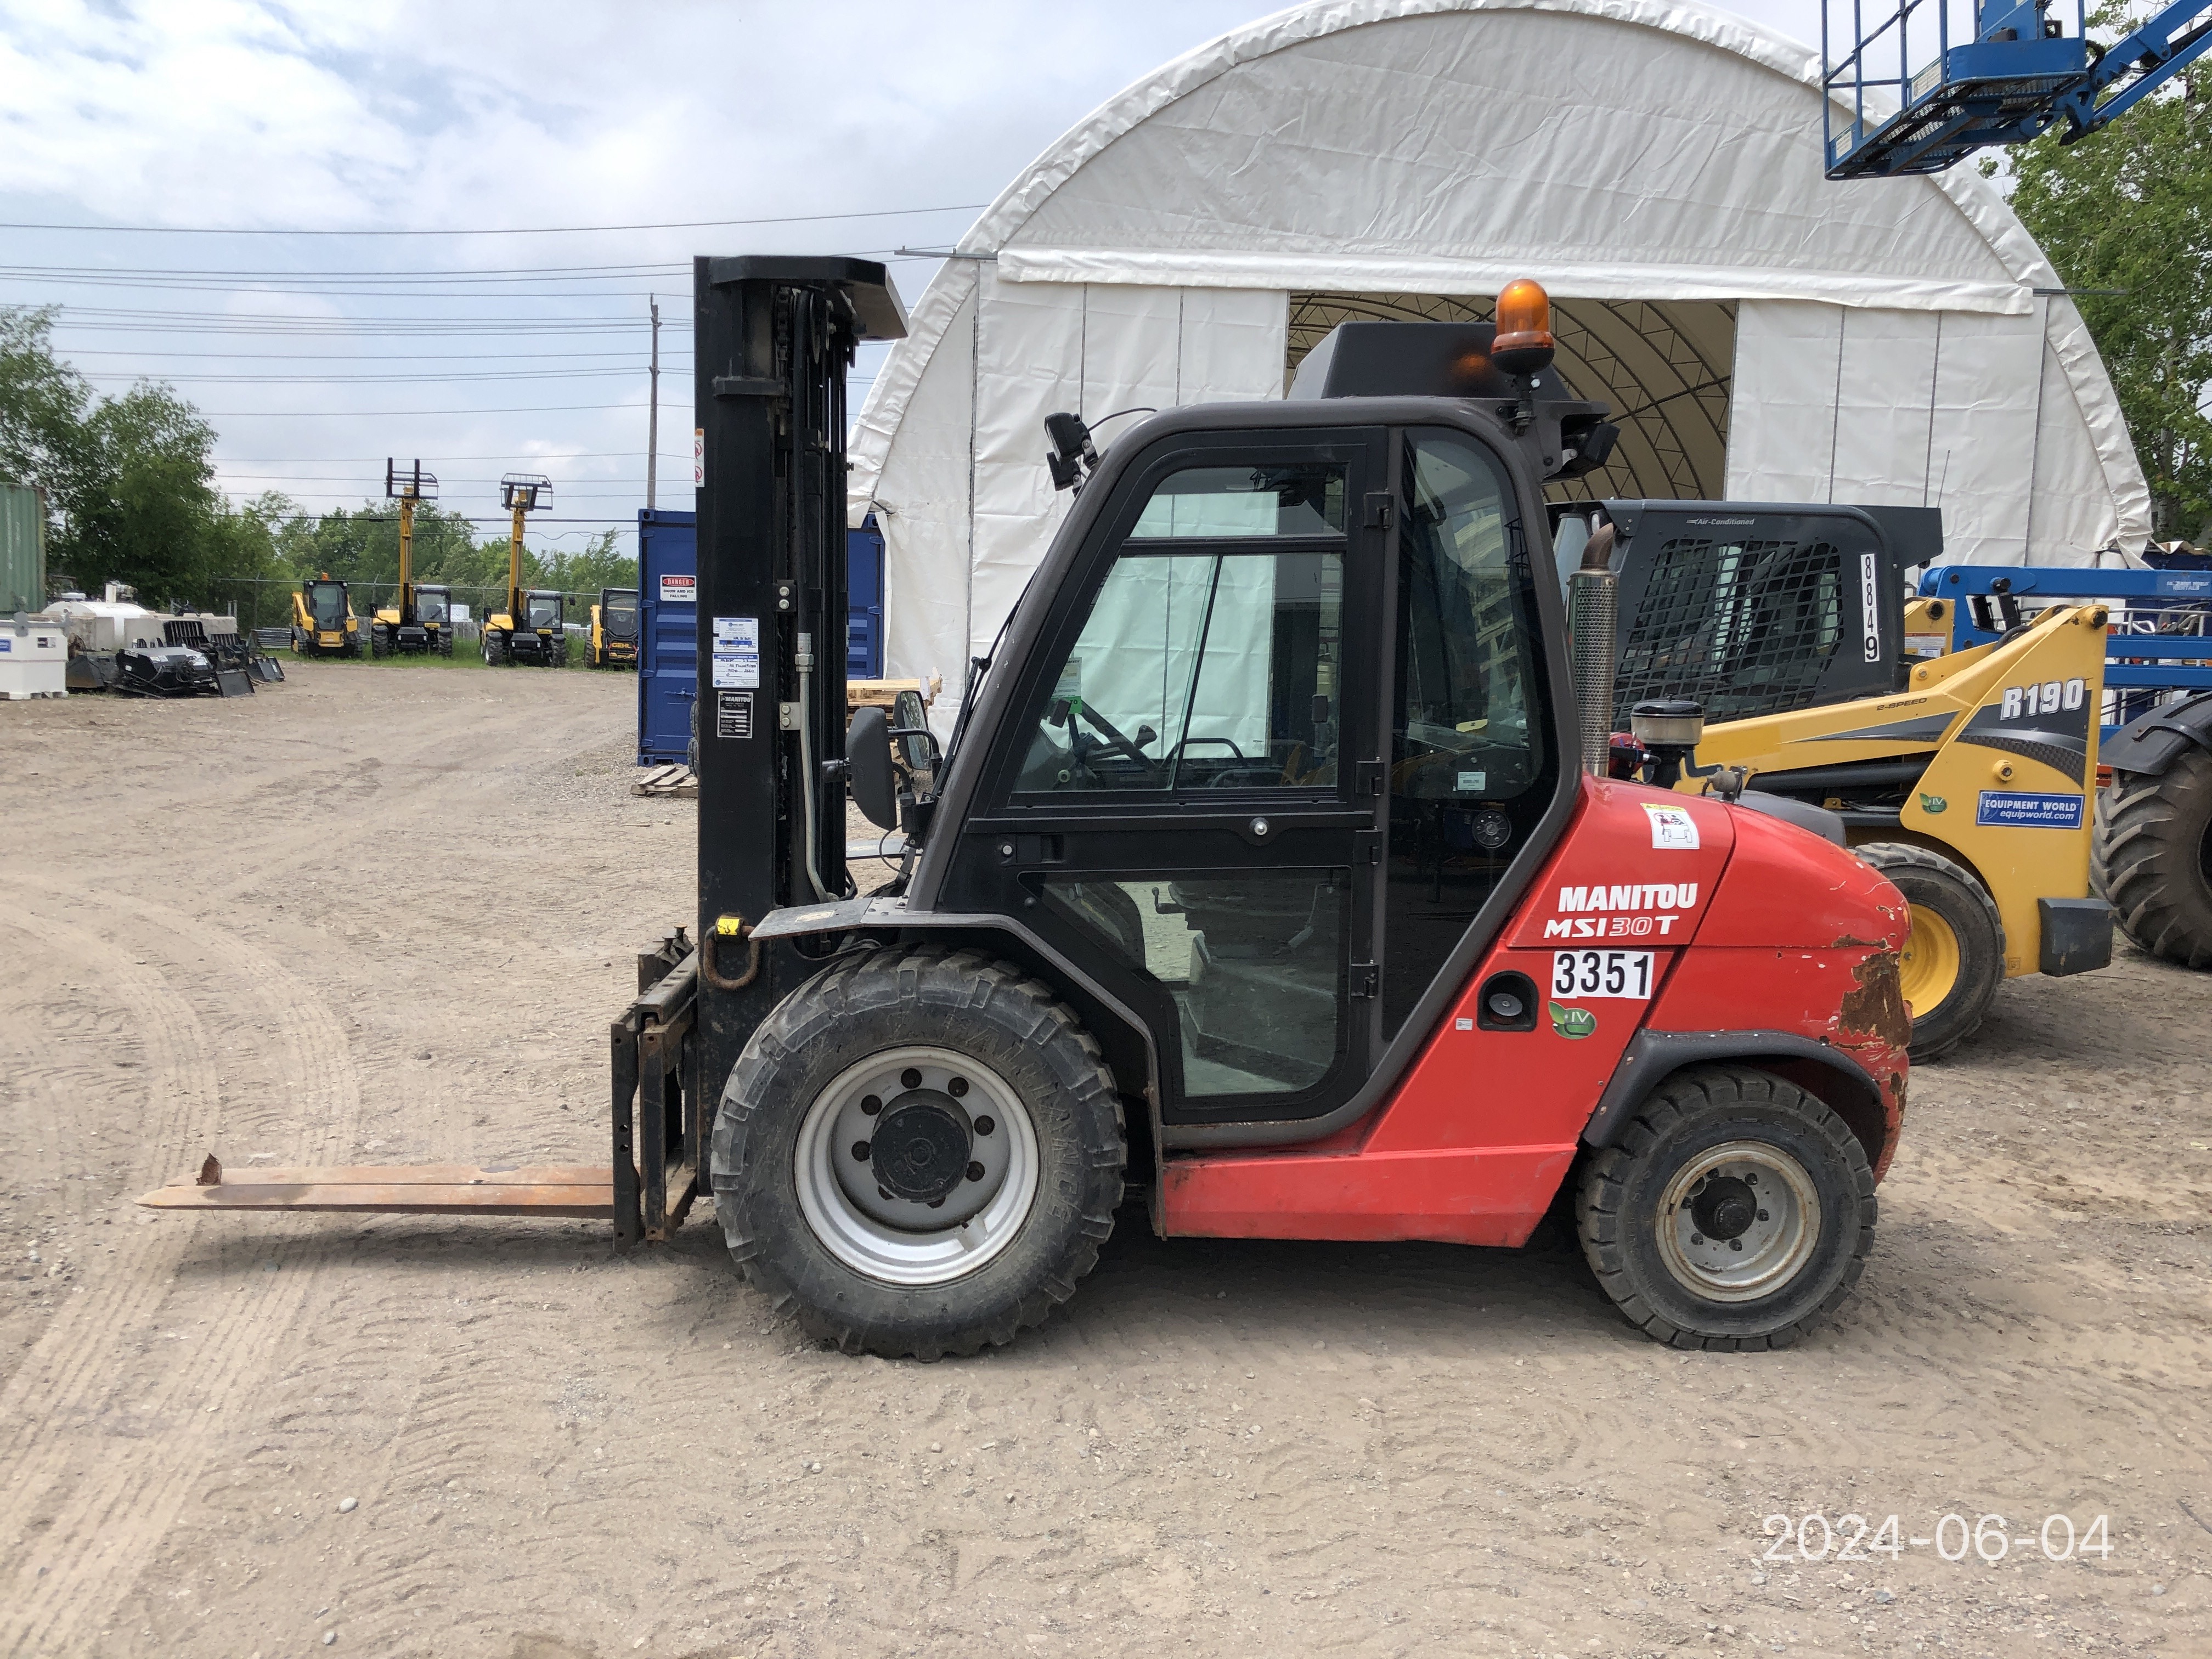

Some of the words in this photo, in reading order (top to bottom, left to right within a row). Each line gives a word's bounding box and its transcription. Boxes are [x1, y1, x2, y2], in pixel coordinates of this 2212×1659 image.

[1865, 556, 1878, 660] 8849
[1876, 698, 1927, 710] 2-SPEED
[2000, 677, 2086, 720] R190
[1985, 799, 2039, 810] EQUIPMENT
[2042, 802, 2077, 812] WORLD
[2000, 810, 2074, 820] equipworld.com
[1558, 883, 1699, 912] MANITOU
[1555, 952, 1649, 996] 3351
[965, 1026, 1080, 1223] ALLIANCE
